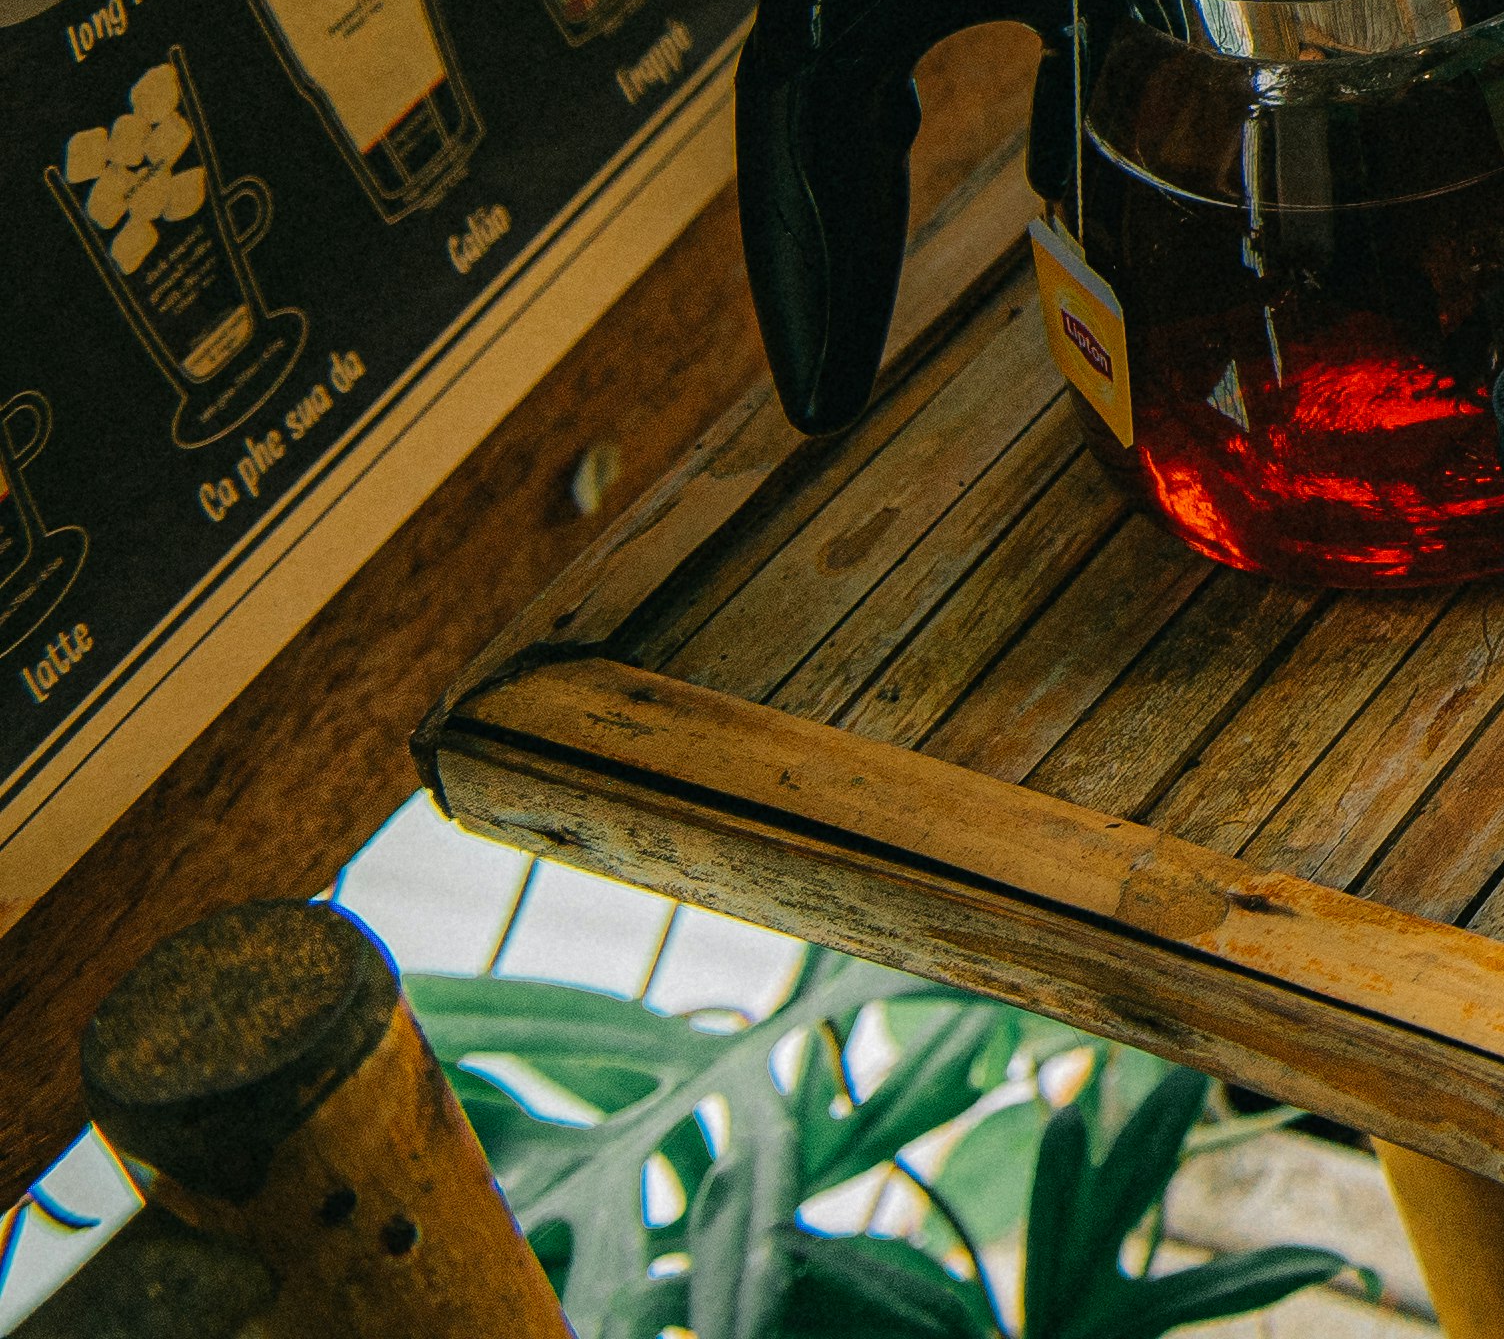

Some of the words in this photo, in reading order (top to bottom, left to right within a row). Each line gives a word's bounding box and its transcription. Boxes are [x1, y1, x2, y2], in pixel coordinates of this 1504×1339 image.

[1065, 316, 1109, 372] Lipton
[199, 473, 241, 523] Ca
[236, 429, 289, 498] phe
[286, 383, 335, 441] sua
[330, 349, 367, 395] da
